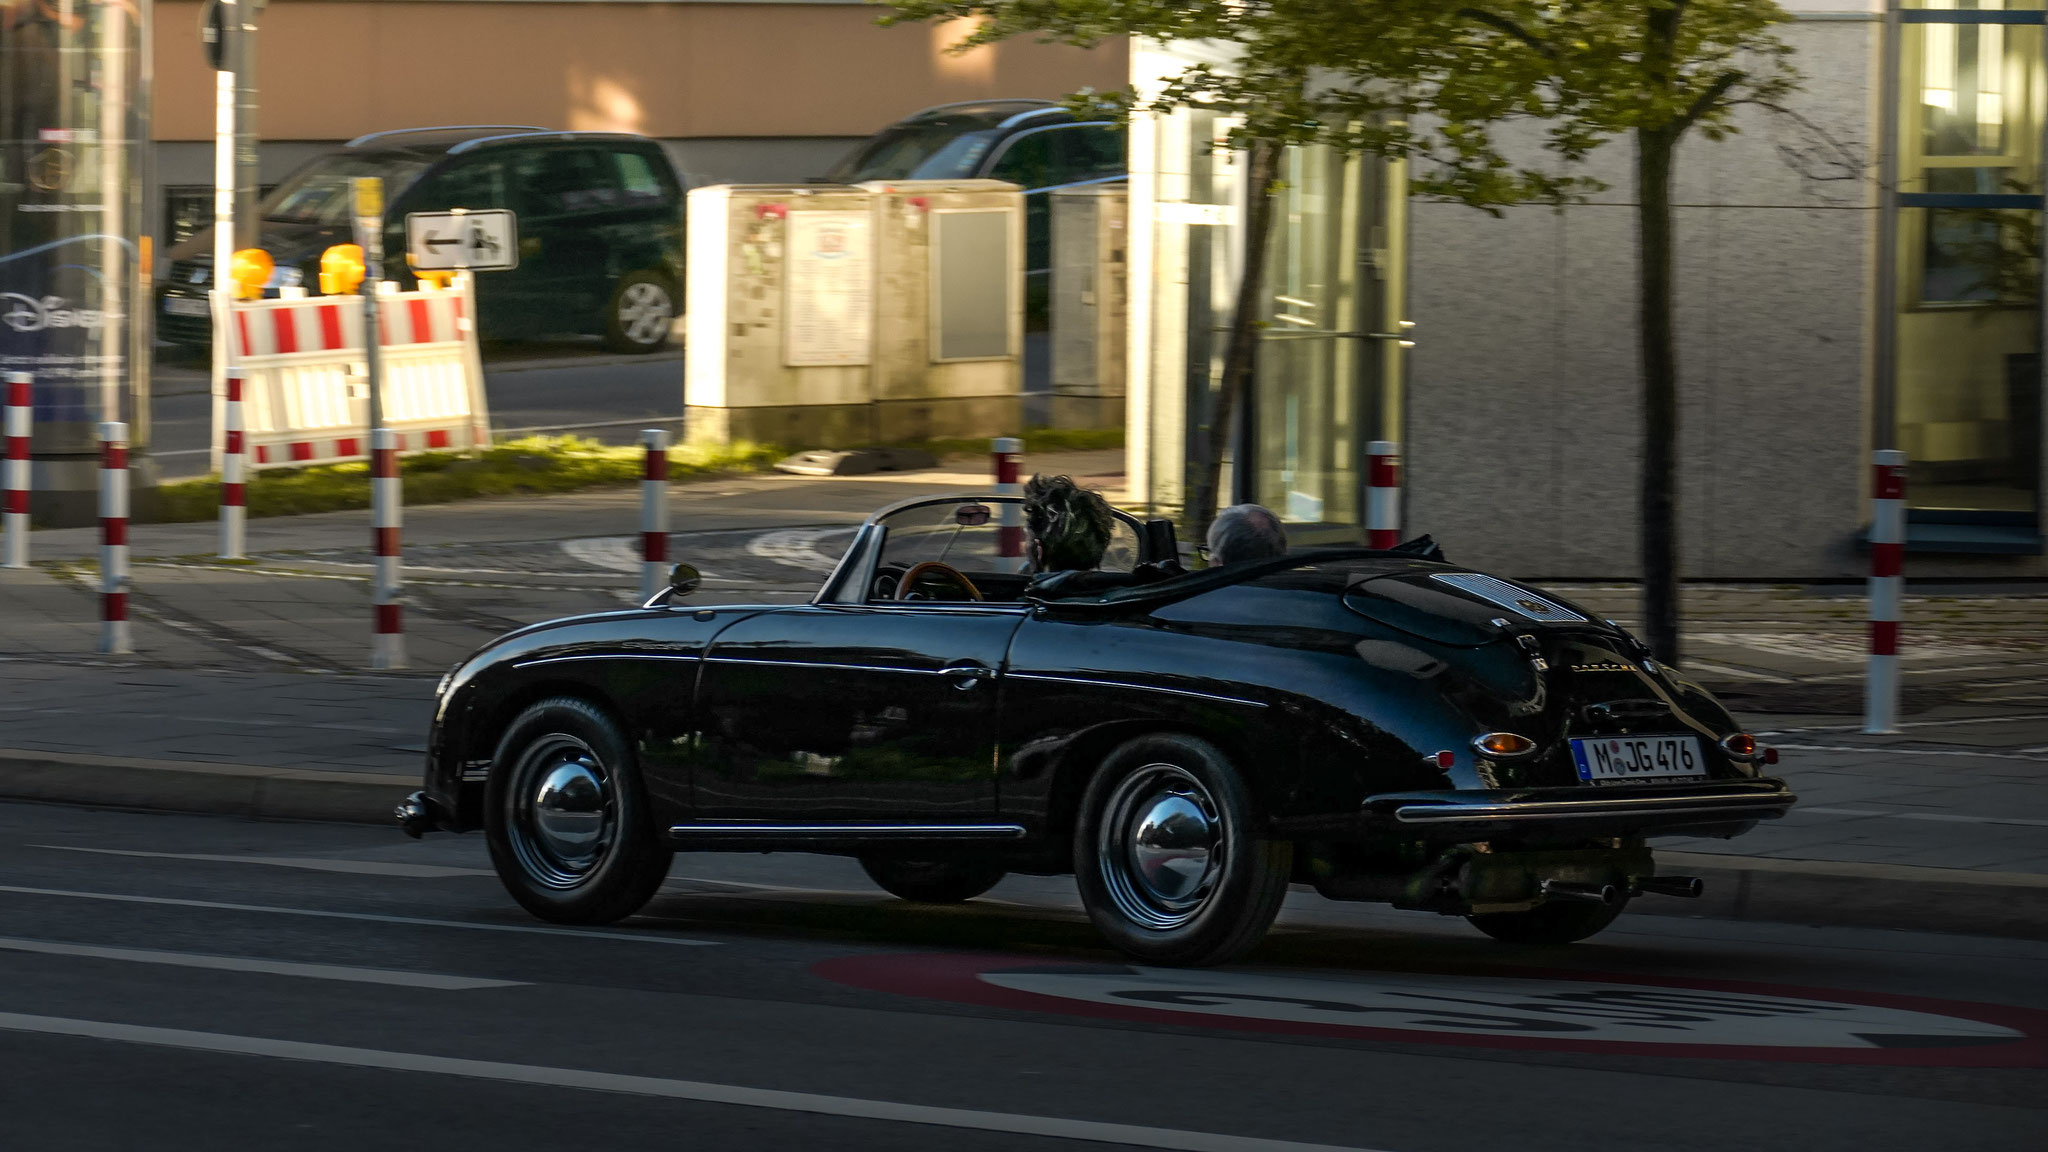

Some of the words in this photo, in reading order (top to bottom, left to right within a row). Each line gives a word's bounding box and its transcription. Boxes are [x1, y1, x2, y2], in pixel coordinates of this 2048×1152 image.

[1593, 743, 1614, 774] M
[1625, 741, 1654, 772] JG
[1657, 740, 1693, 771] 476
